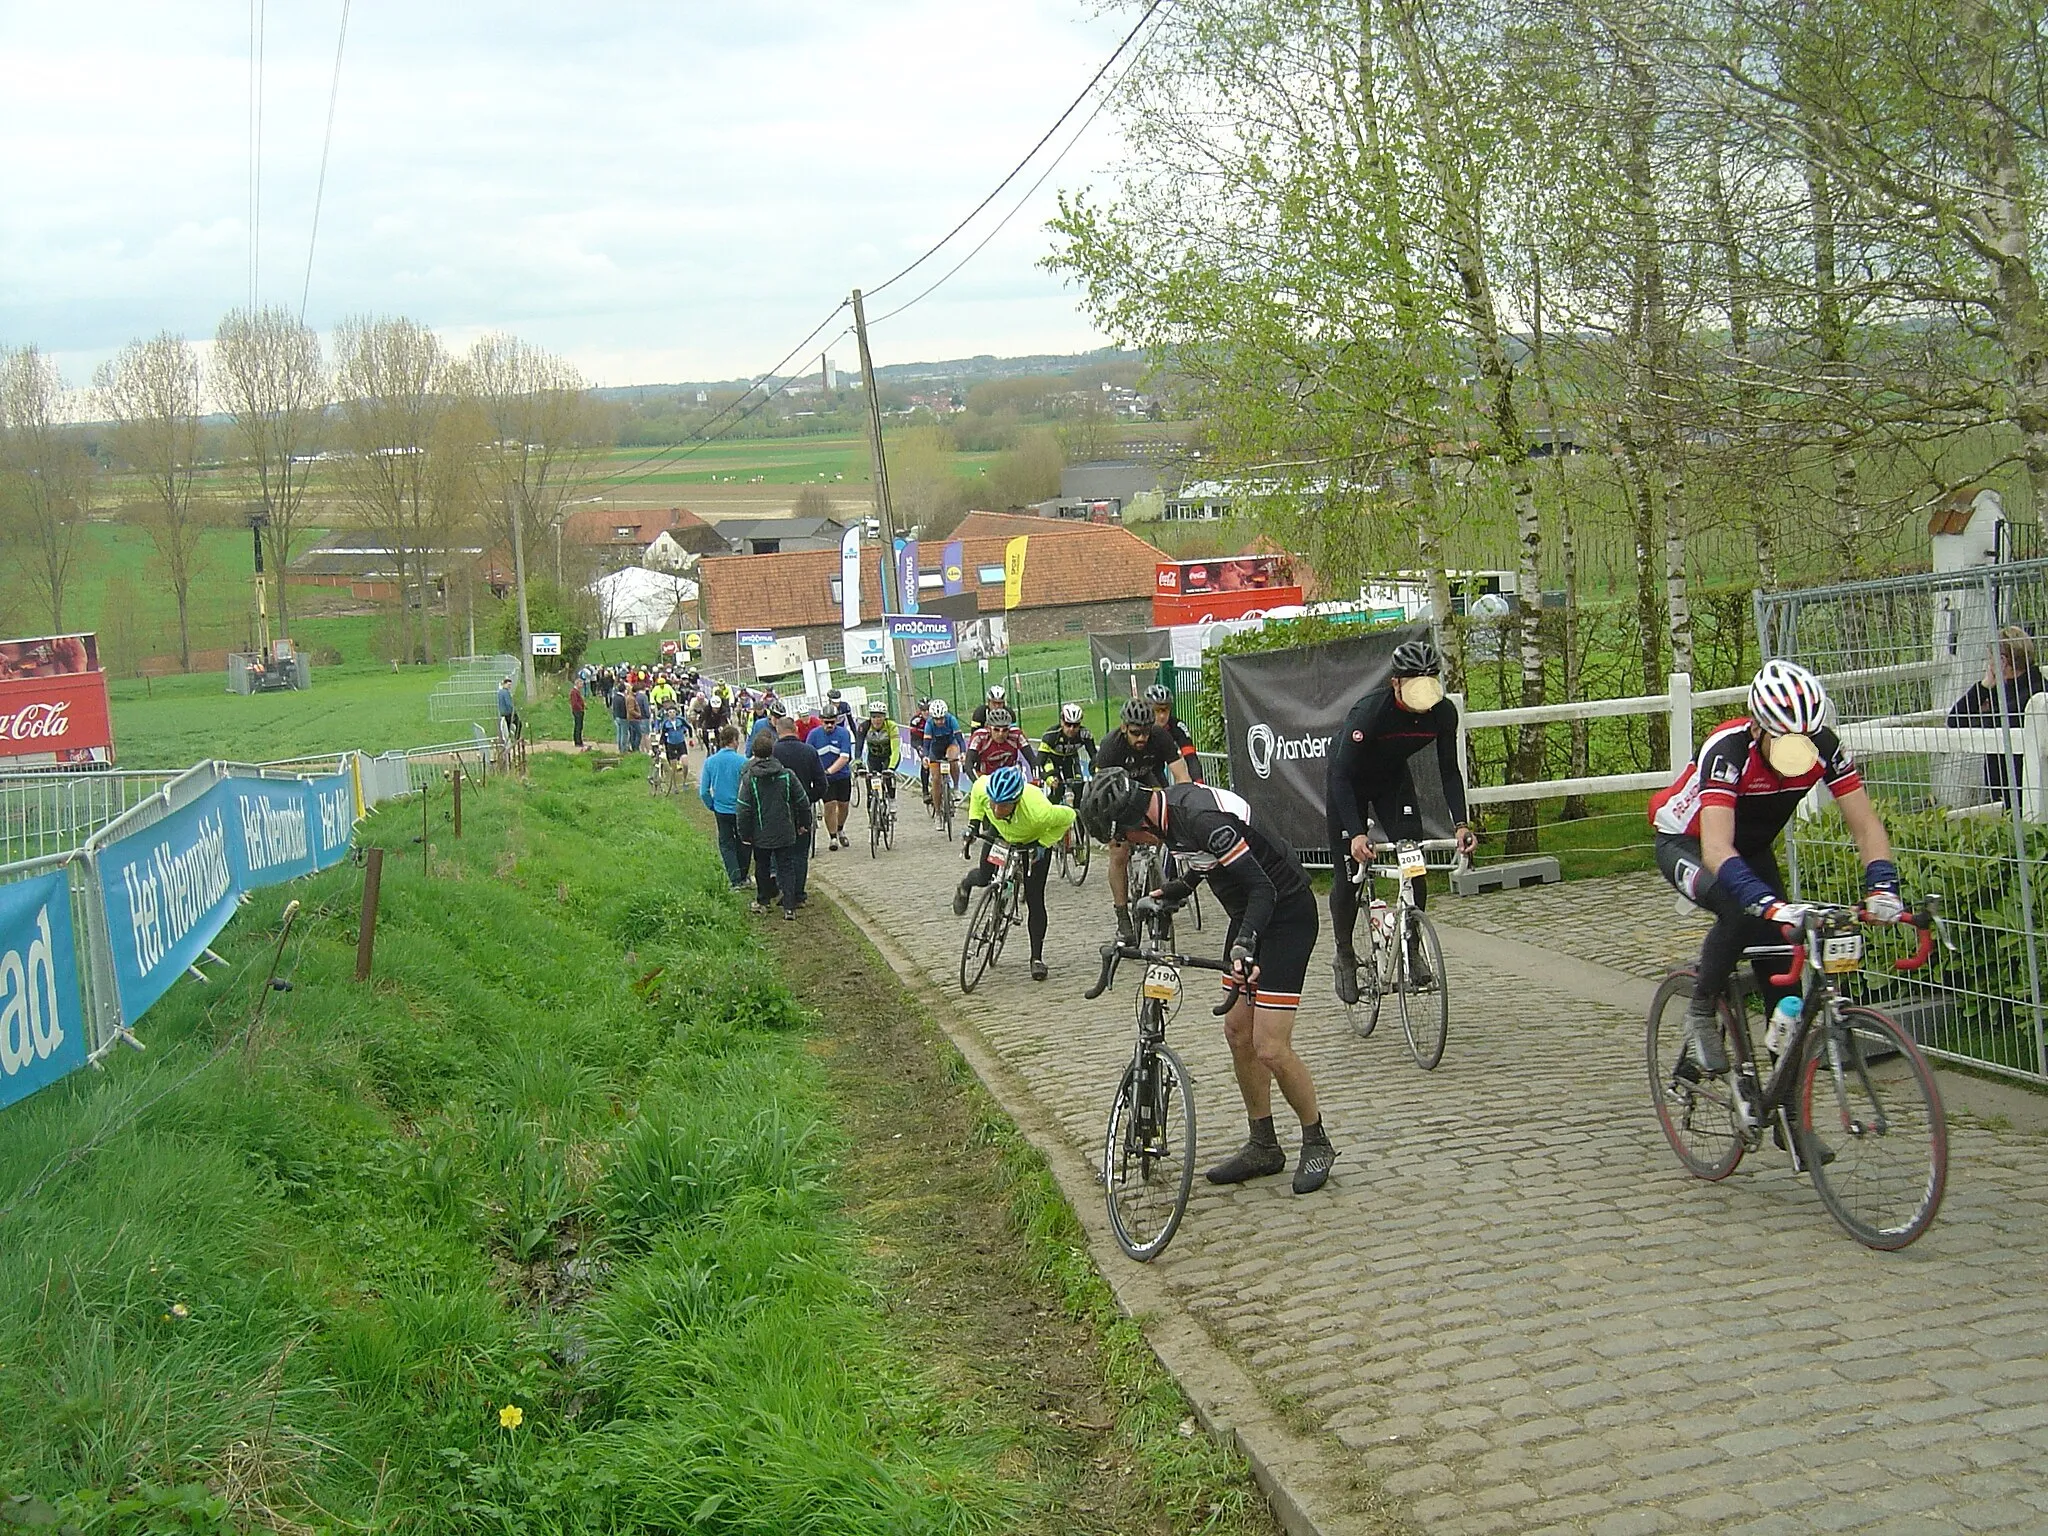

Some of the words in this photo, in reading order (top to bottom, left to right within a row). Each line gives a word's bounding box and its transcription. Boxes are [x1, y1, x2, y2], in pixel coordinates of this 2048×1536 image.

[1275, 732, 1333, 760] flander
[239, 795, 266, 871] Het
[1400, 854, 1422, 864] 2037
[123, 858, 164, 978] Het
[1149, 970, 1176, 982] 2190
